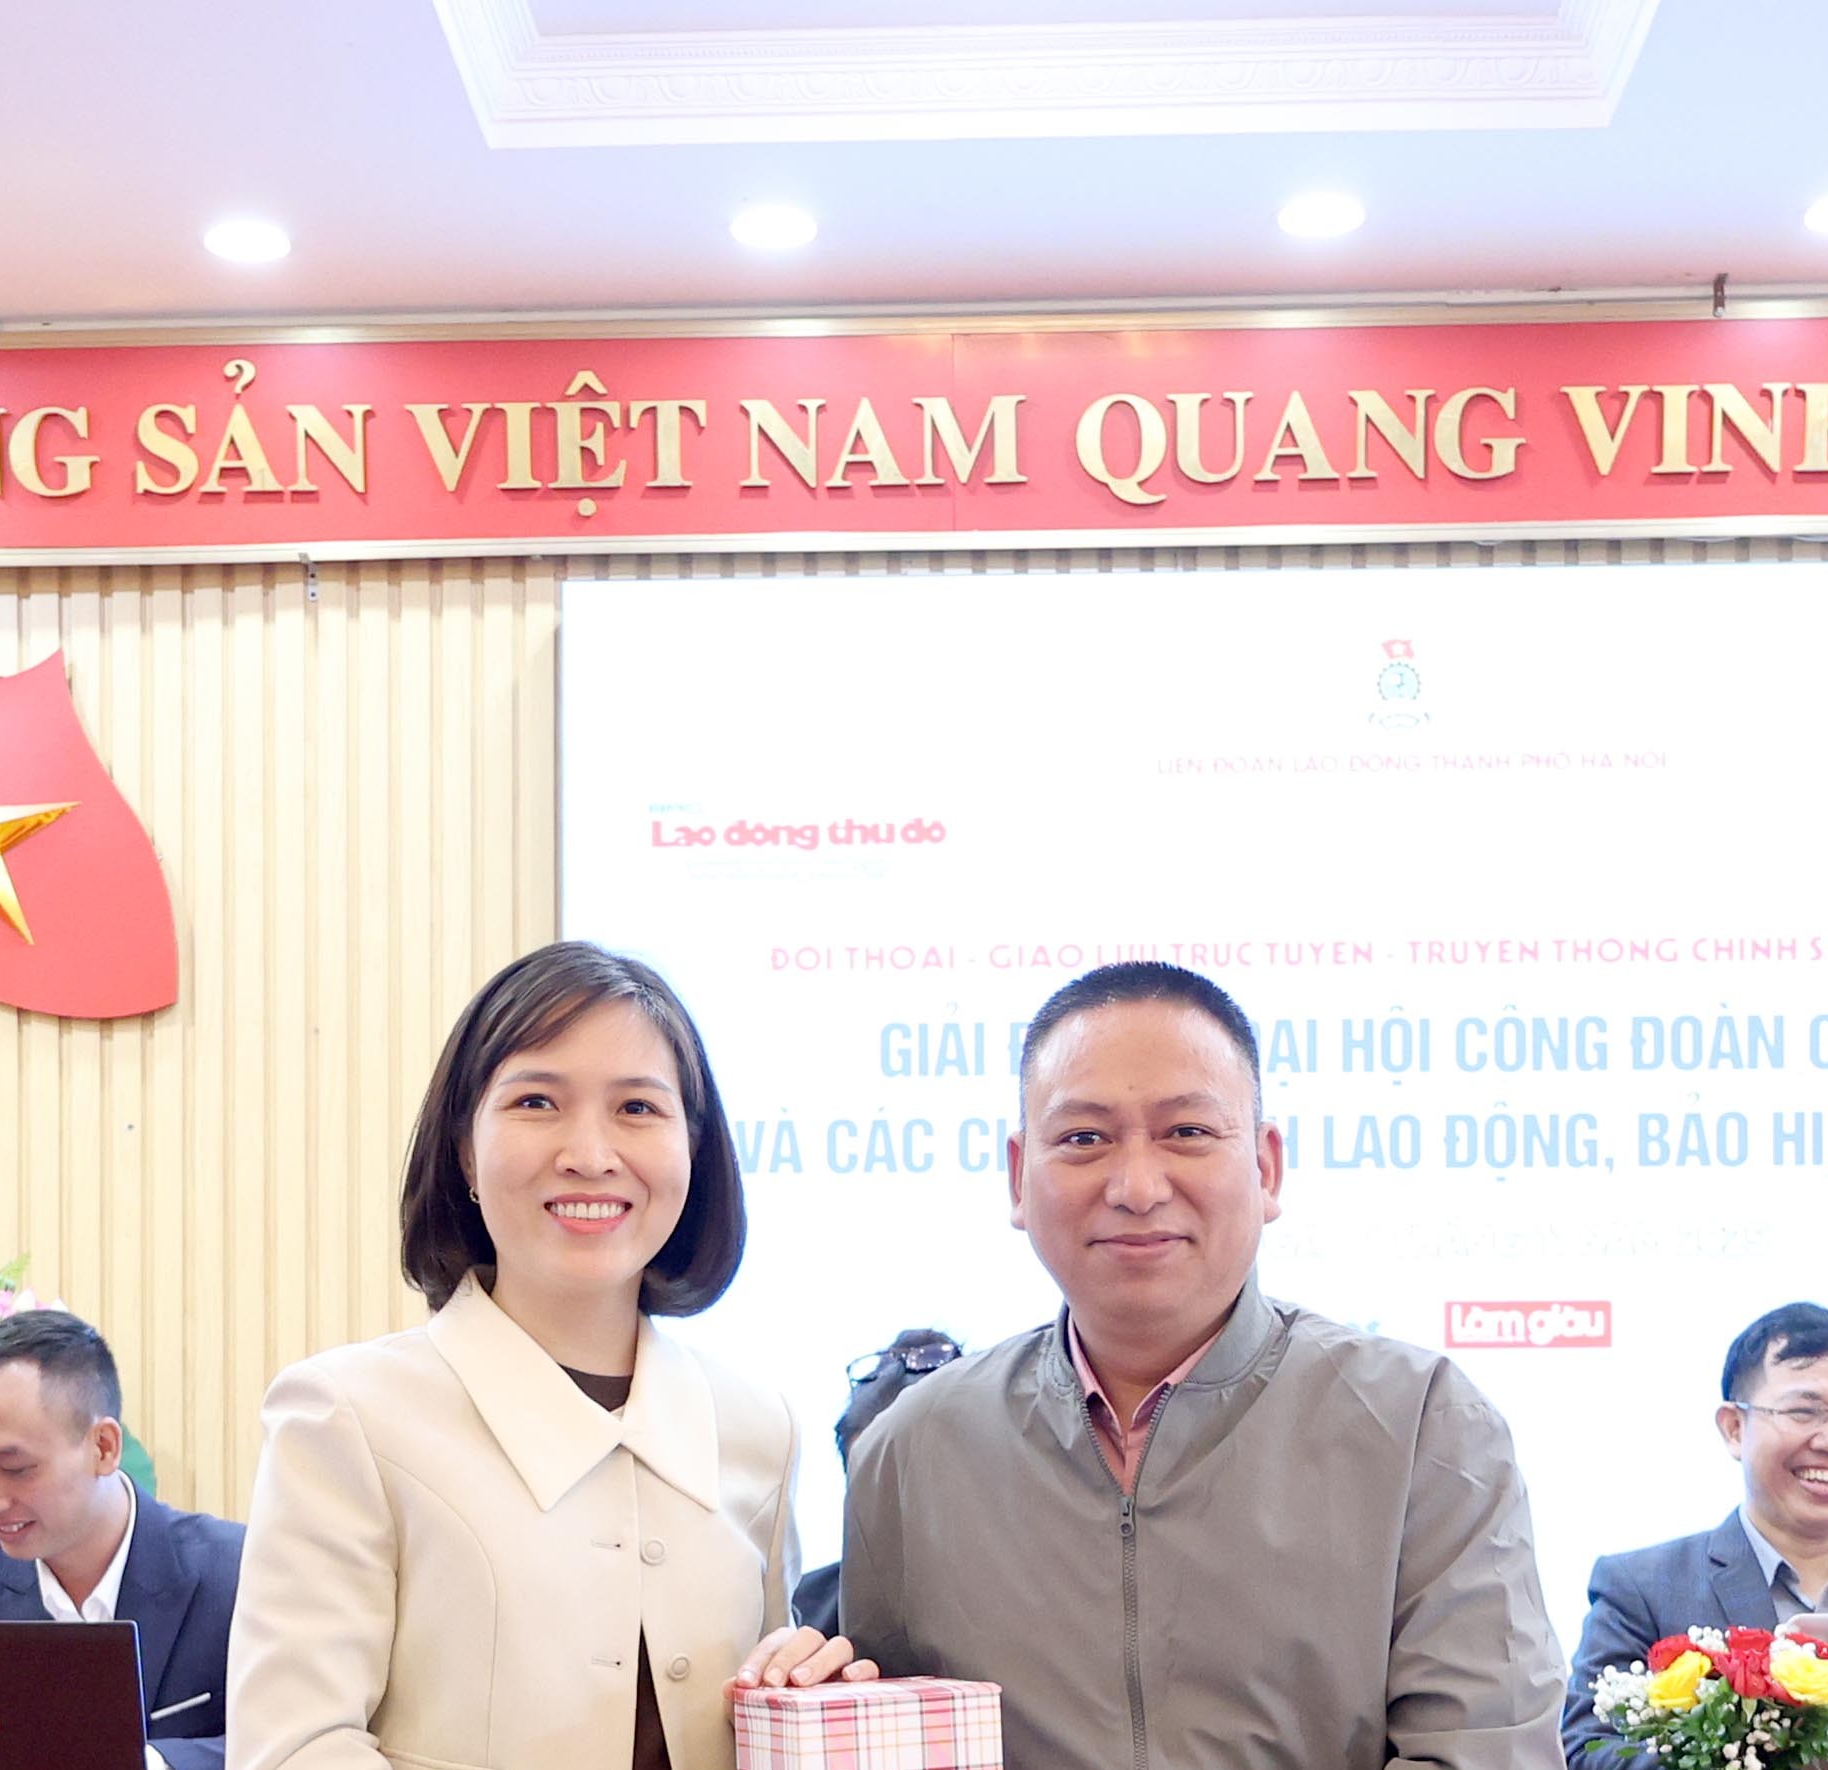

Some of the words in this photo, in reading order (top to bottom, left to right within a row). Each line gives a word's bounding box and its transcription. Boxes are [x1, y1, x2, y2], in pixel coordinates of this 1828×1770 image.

[135, 360, 370, 500] SẢN
[404, 370, 707, 516] VIỆT
[739, 391, 1028, 490] NAM
[1075, 383, 1527, 504] QUANG
[653, 820, 716, 847] Lao
[989, 943, 1084, 969] GIAO
[880, 1002, 986, 1078] GIẢI
[1255, 1019, 1318, 1088] ẠI
[1342, 1004, 1430, 1086] HỘI
[1455, 1002, 1608, 1073] CÔNG
[1630, 1000, 1785, 1071] ĐOÀN
[735, 1106, 803, 1175] VÀ
[825, 1106, 935, 1175] CÁC
[1323, 1113, 1422, 1170] LAO
[1443, 1100, 1614, 1183] ĐỘNG,
[1637, 1091, 1749, 1168] BẢO
